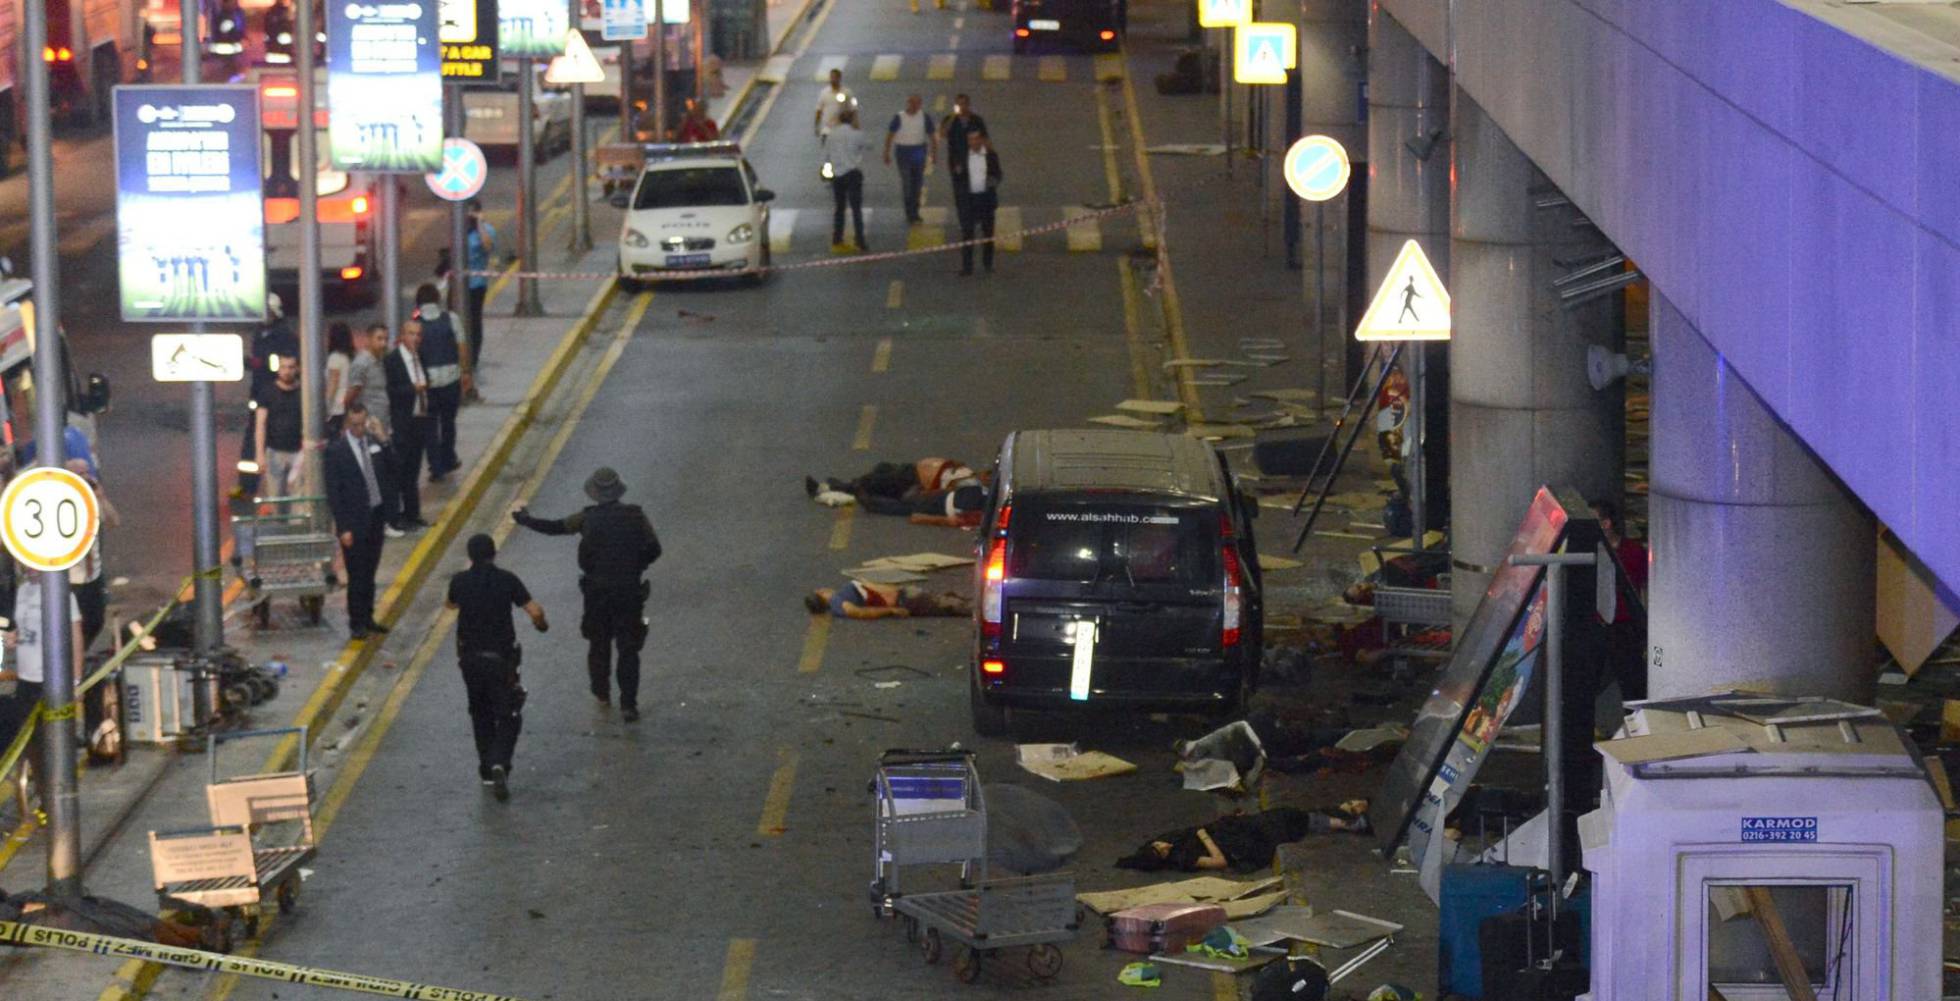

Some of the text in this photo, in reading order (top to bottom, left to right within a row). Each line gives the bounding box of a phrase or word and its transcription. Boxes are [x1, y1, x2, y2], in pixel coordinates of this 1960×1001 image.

[24, 498, 78, 539] 30
[1743, 818, 1816, 829] KARMOD
[1789, 831, 1801, 840] 20
[1803, 831, 1816, 840] 45
